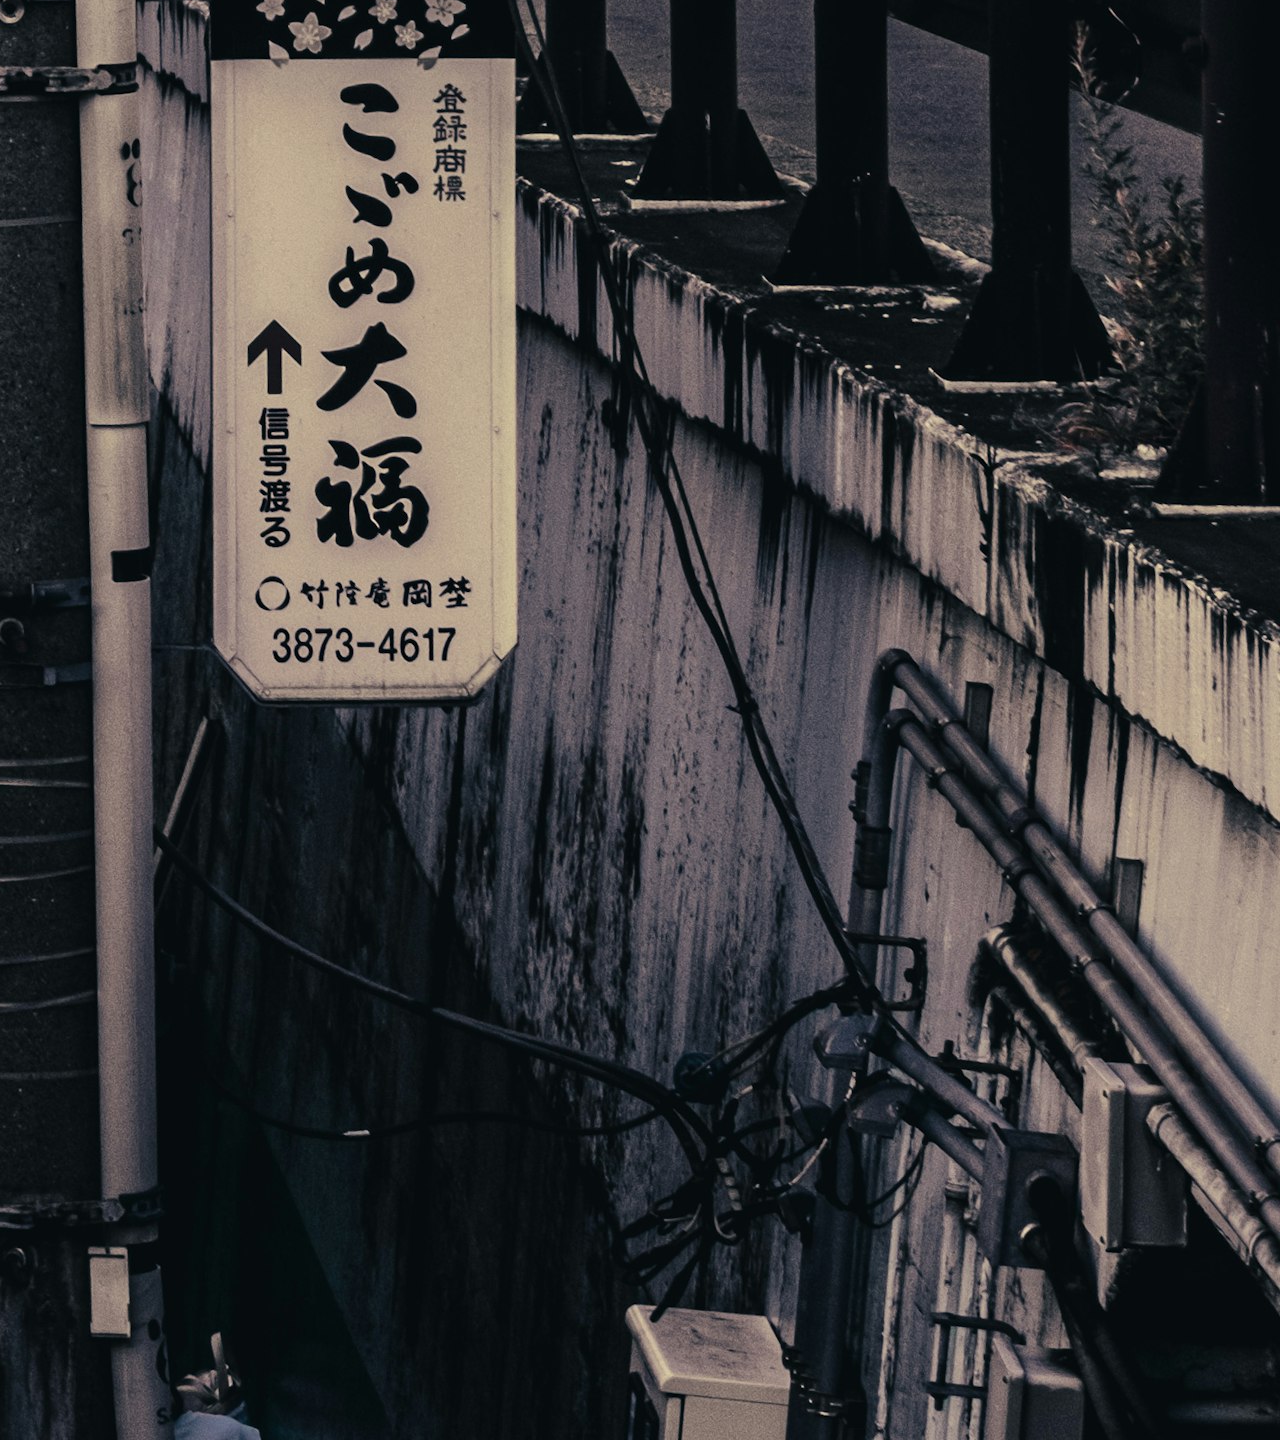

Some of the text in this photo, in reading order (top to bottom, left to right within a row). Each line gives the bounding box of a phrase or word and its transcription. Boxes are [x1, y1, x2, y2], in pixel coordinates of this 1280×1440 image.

[431, 84, 468, 203] 登録商標
[257, 406, 293, 549] 信号渡る
[272, 627, 456, 664] 3873-4617
